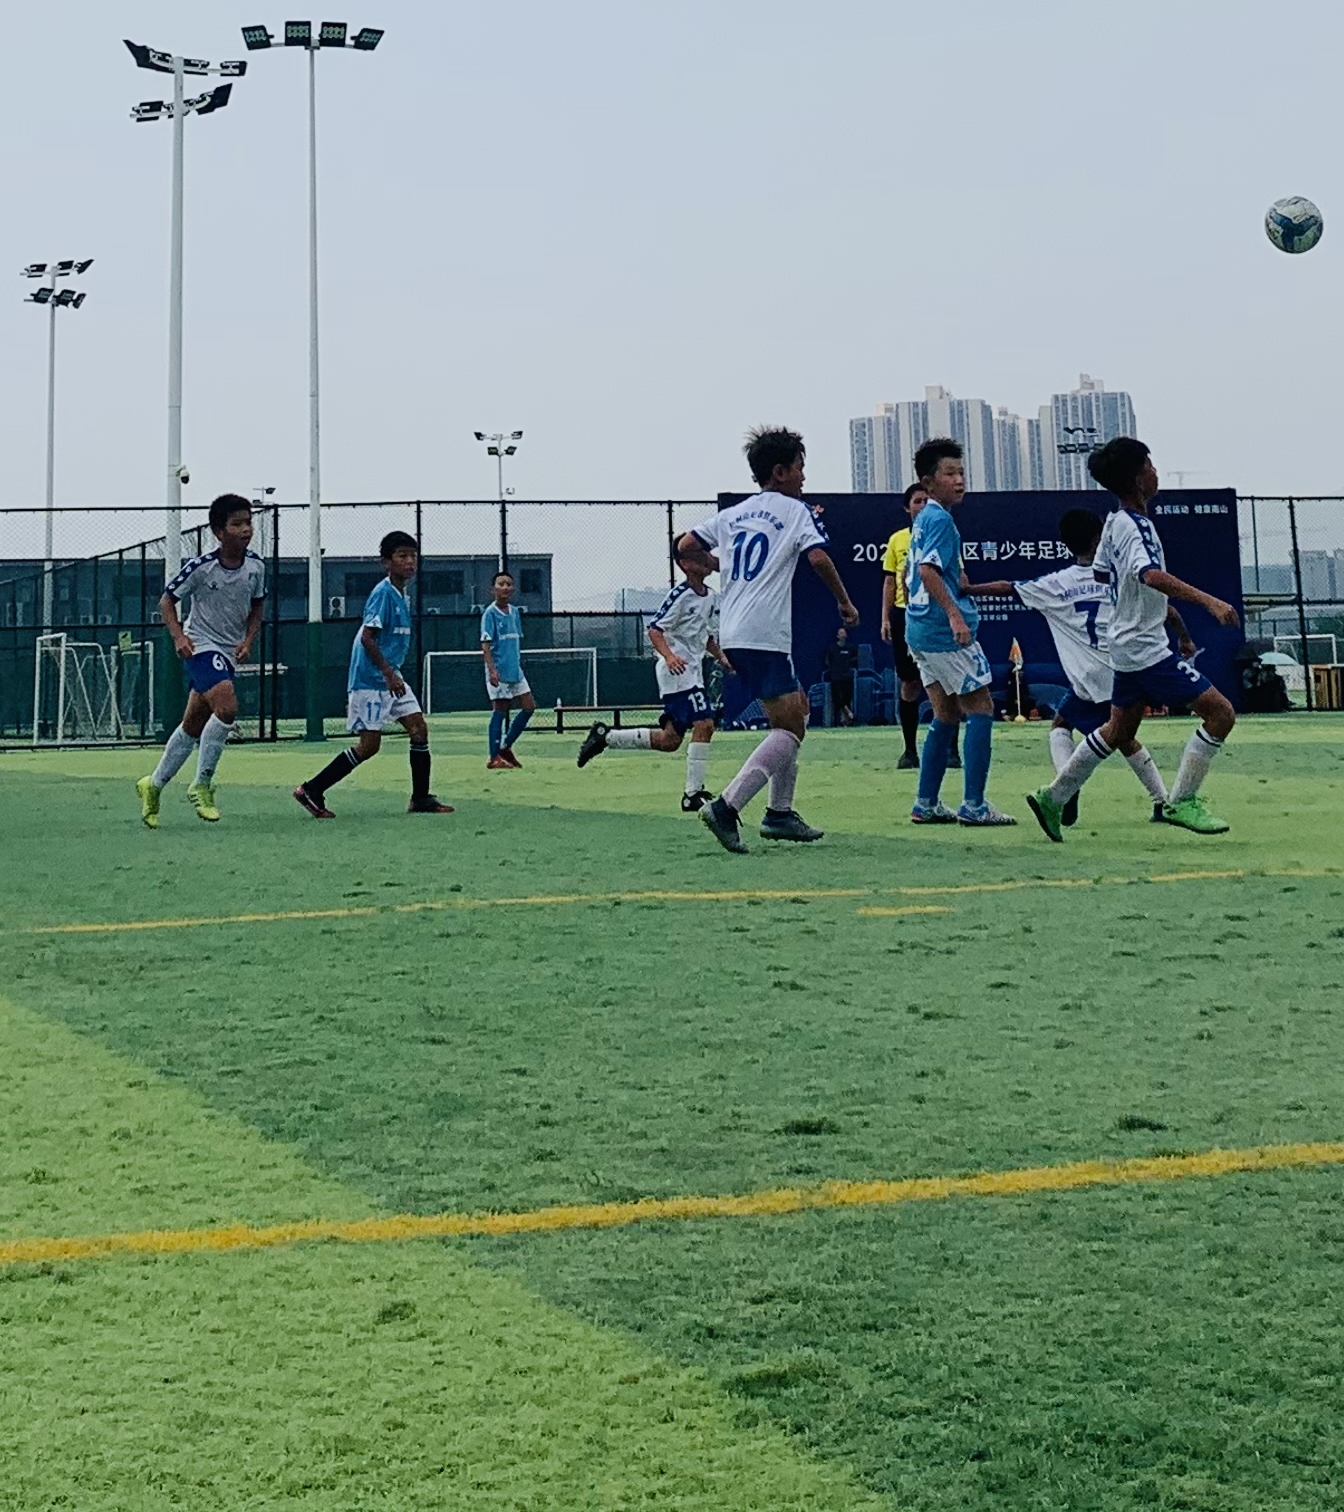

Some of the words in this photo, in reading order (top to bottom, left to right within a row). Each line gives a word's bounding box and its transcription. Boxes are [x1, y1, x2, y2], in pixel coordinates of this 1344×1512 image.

[731, 531, 769, 581] 10
[1074, 601, 1101, 649] 7
[1177, 661, 1201, 682] 3
[367, 701, 382, 721] 17
[688, 691, 707, 713] 13
